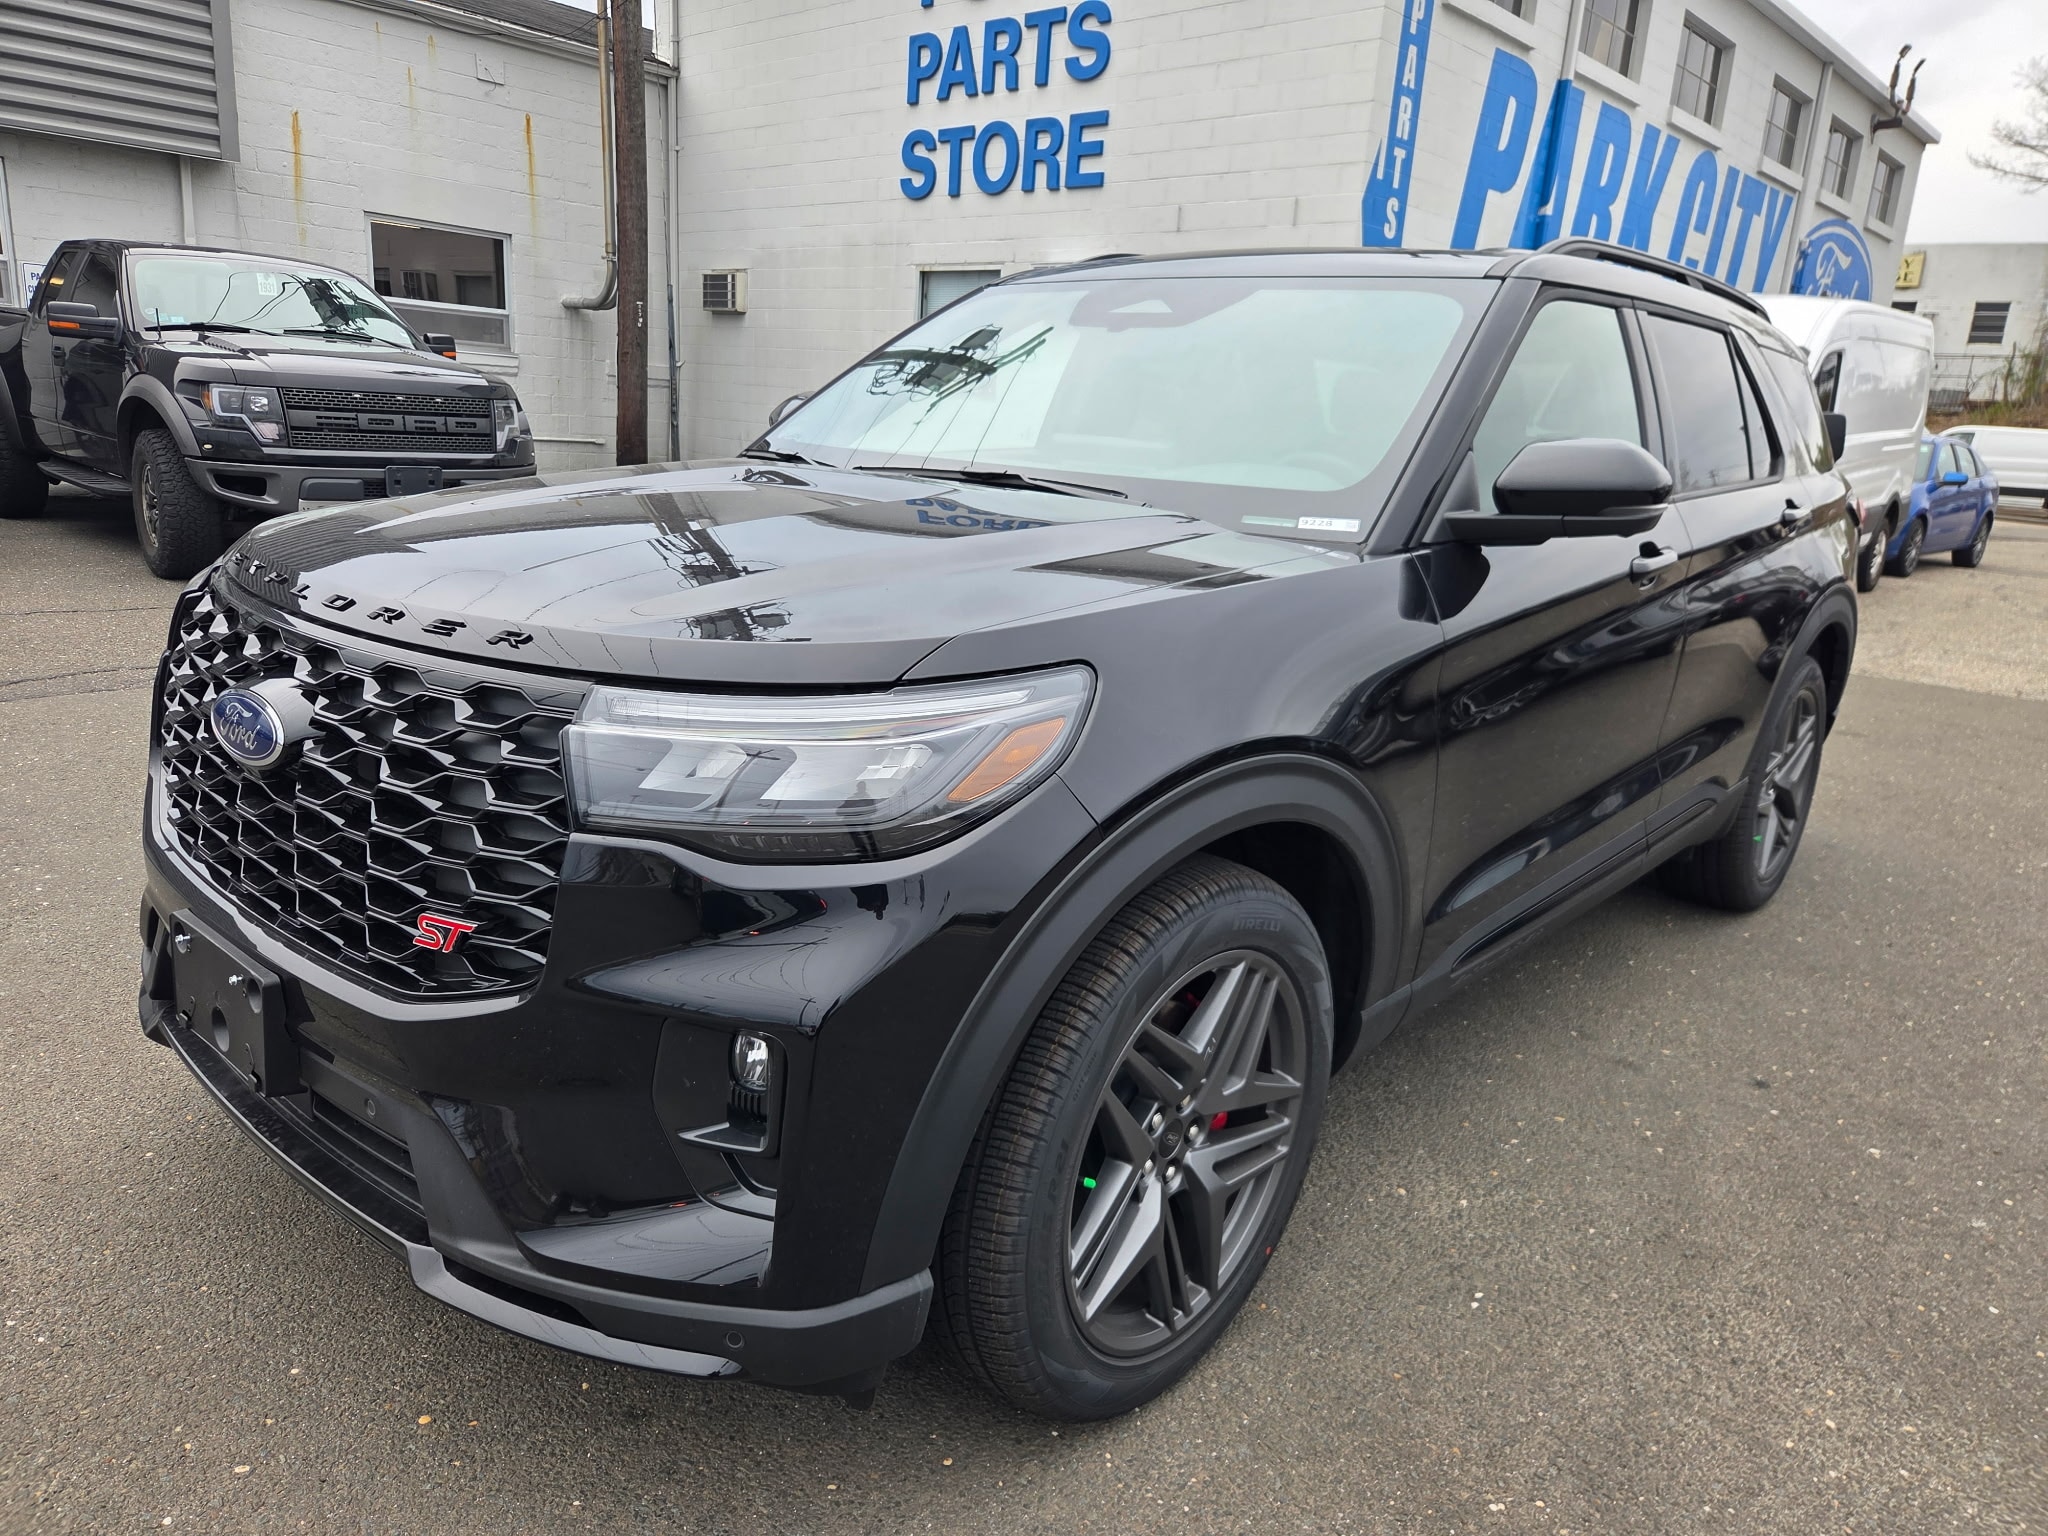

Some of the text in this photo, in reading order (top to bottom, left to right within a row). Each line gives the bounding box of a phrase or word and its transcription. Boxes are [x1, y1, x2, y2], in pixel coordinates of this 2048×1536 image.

[907, 0, 1112, 105] PARTS
[900, 110, 1109, 200] STORE
[1384, 0, 1425, 239] PARTS
[1450, 47, 1794, 294] PARK CITY
[1806, 241, 1860, 299] Fd
[296, 411, 490, 434] FORD
[231, 552, 534, 649] EXPLORER
[220, 702, 262, 750] Ford
[413, 913, 478, 953] ST
